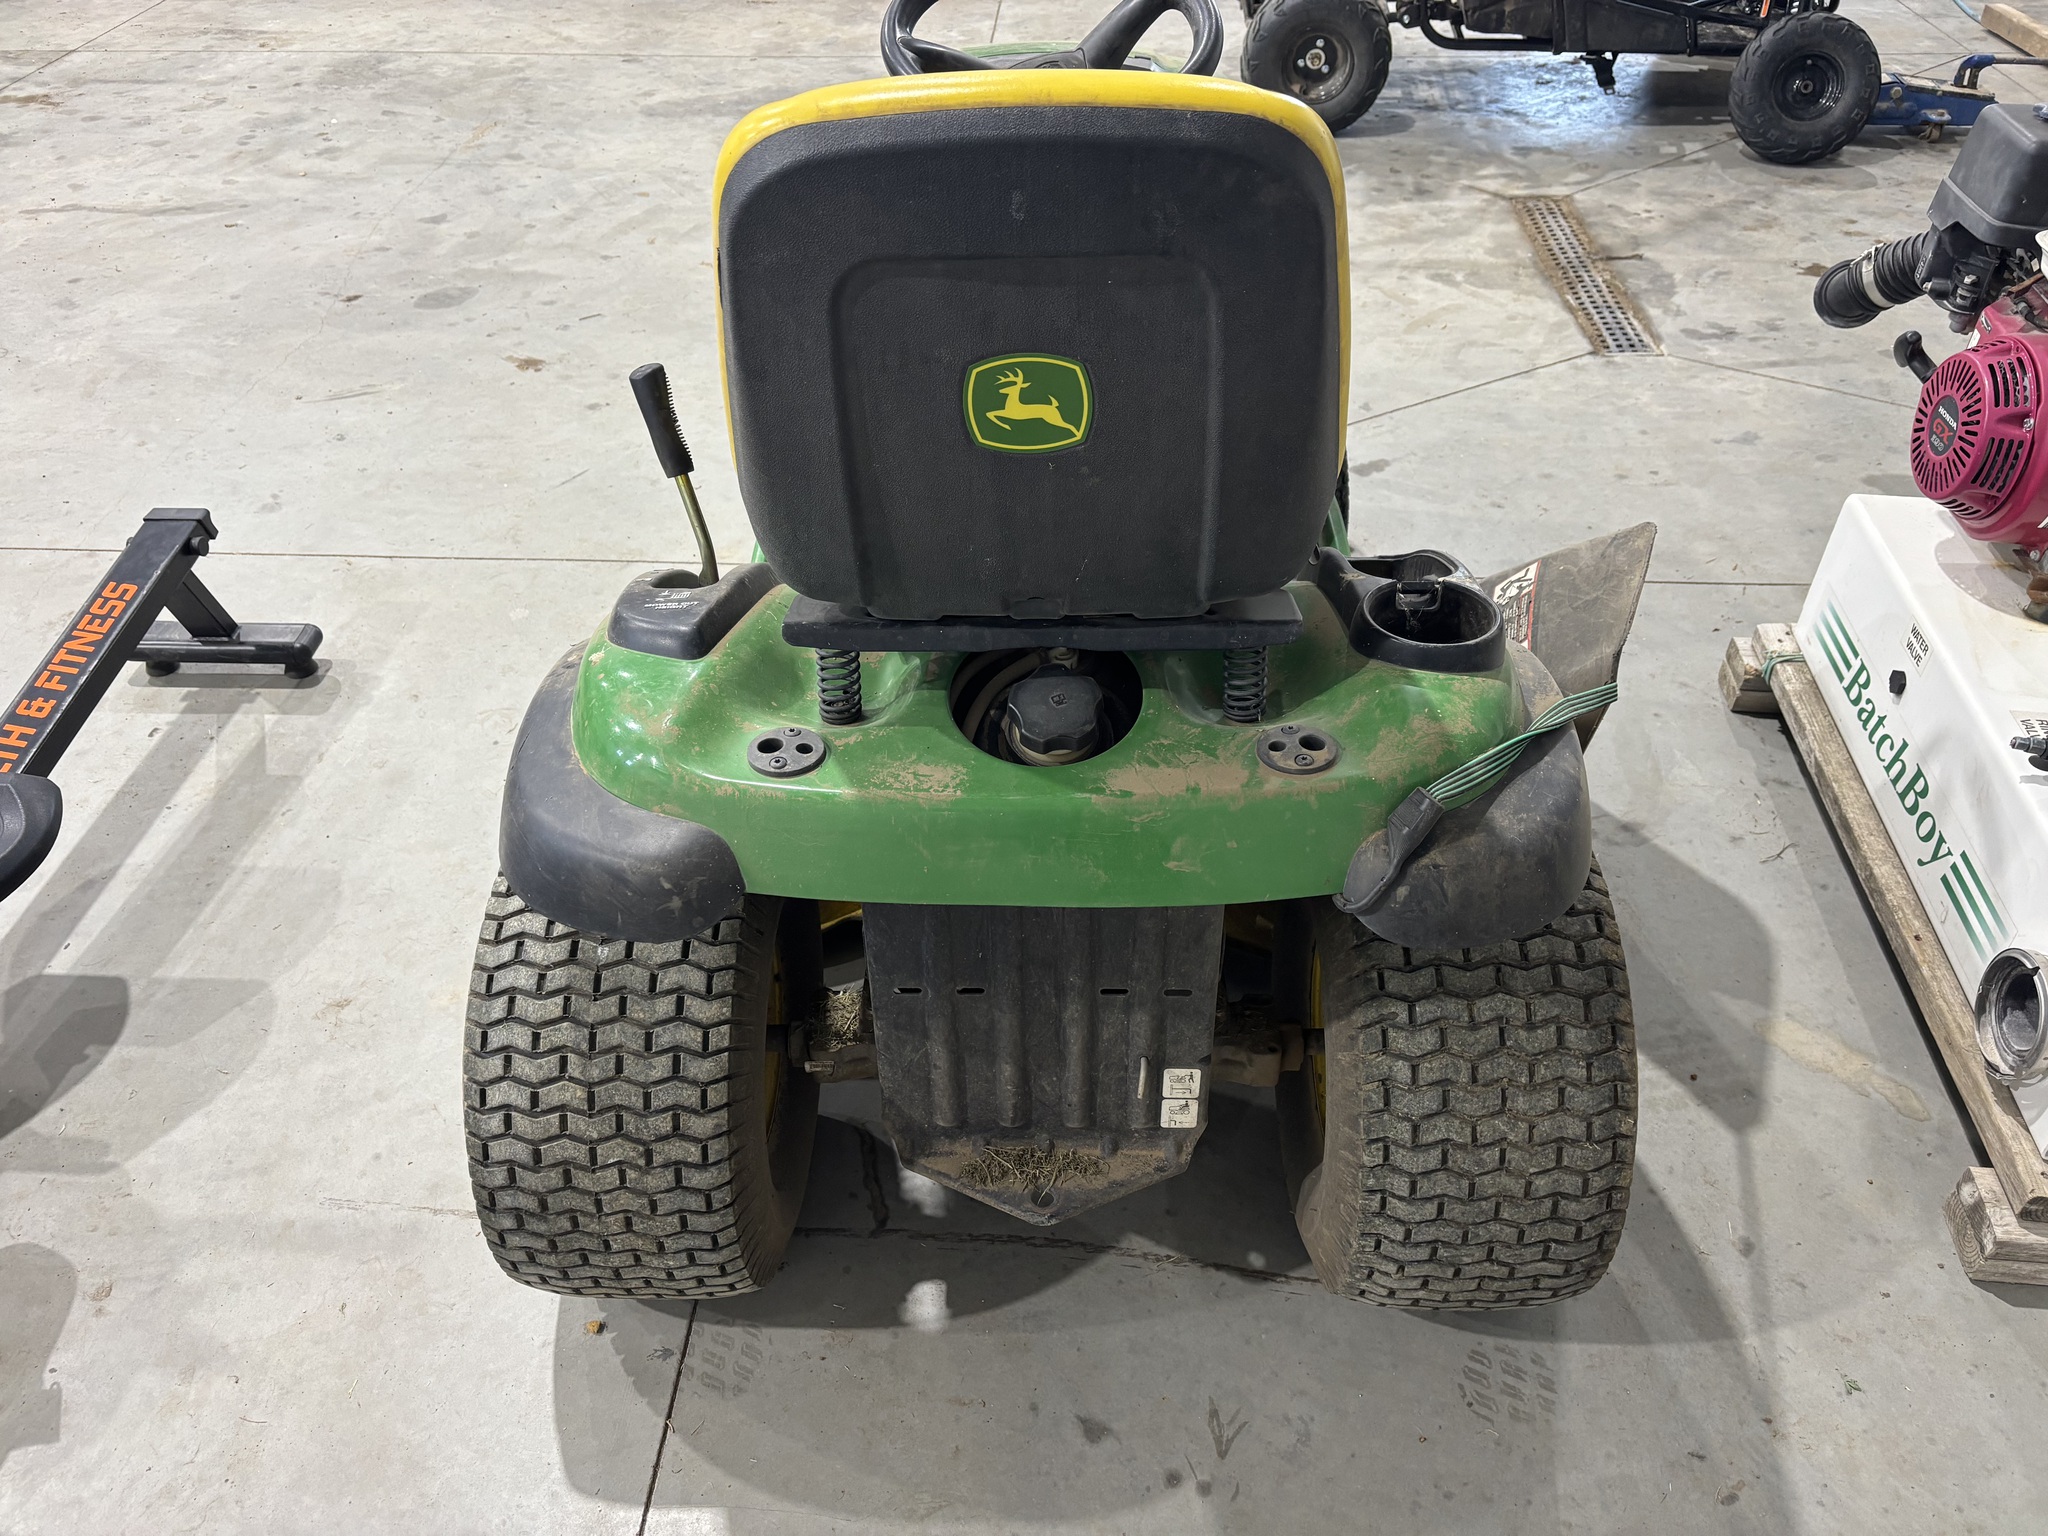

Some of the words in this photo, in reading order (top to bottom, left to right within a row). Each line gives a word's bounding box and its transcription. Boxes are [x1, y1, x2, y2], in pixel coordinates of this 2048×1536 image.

[1933, 418, 1954, 445] GX
[1938, 405, 1957, 431] HONDA
[34, 581, 138, 691] FITNESS
[1906, 636, 1922, 668] VALVE
[1910, 622, 1929, 657] WATER
[15, 697, 56, 719] &
[1843, 658, 1953, 866] BatchBoy
